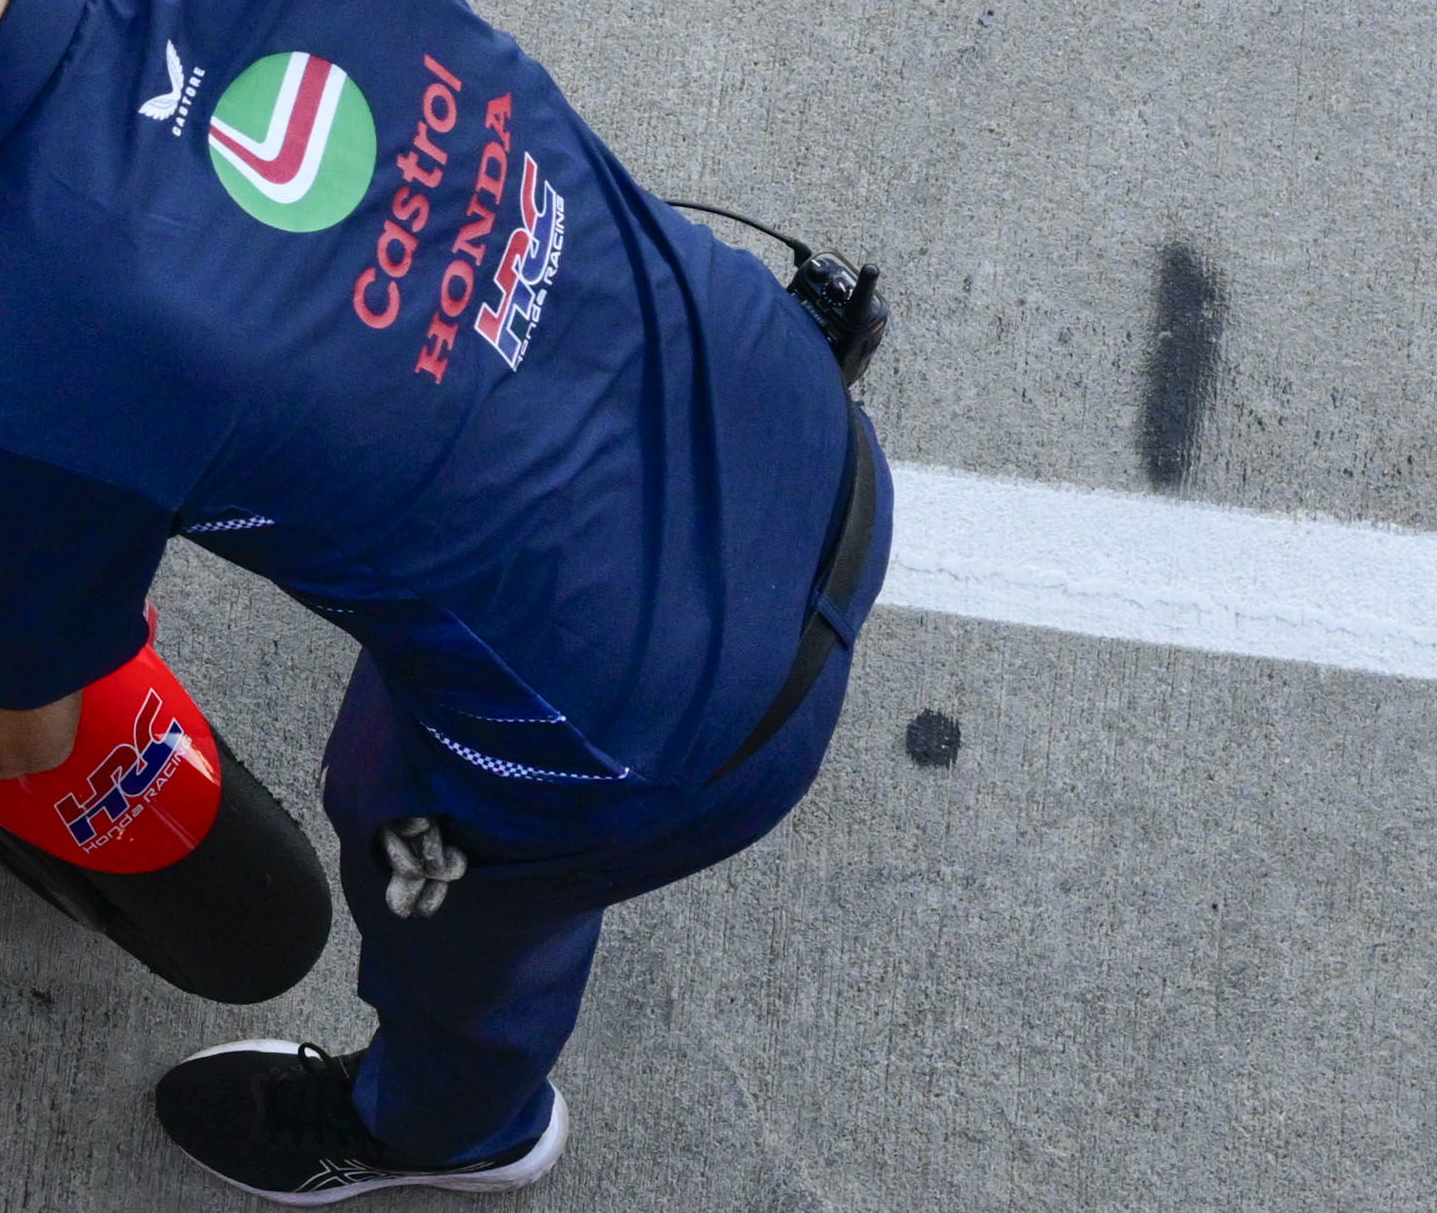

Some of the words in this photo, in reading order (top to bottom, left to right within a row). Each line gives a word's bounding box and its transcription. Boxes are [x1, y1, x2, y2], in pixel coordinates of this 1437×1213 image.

[173, 66, 206, 137] CASTORE
[353, 54, 463, 329] Castrol
[415, 92, 513, 385] HONDA
[474, 151, 557, 370] HRC
[543, 193, 566, 284] RACING
[54, 688, 184, 847] HRC
[82, 790, 146, 855] Honda
[143, 732, 194, 803] RACING
